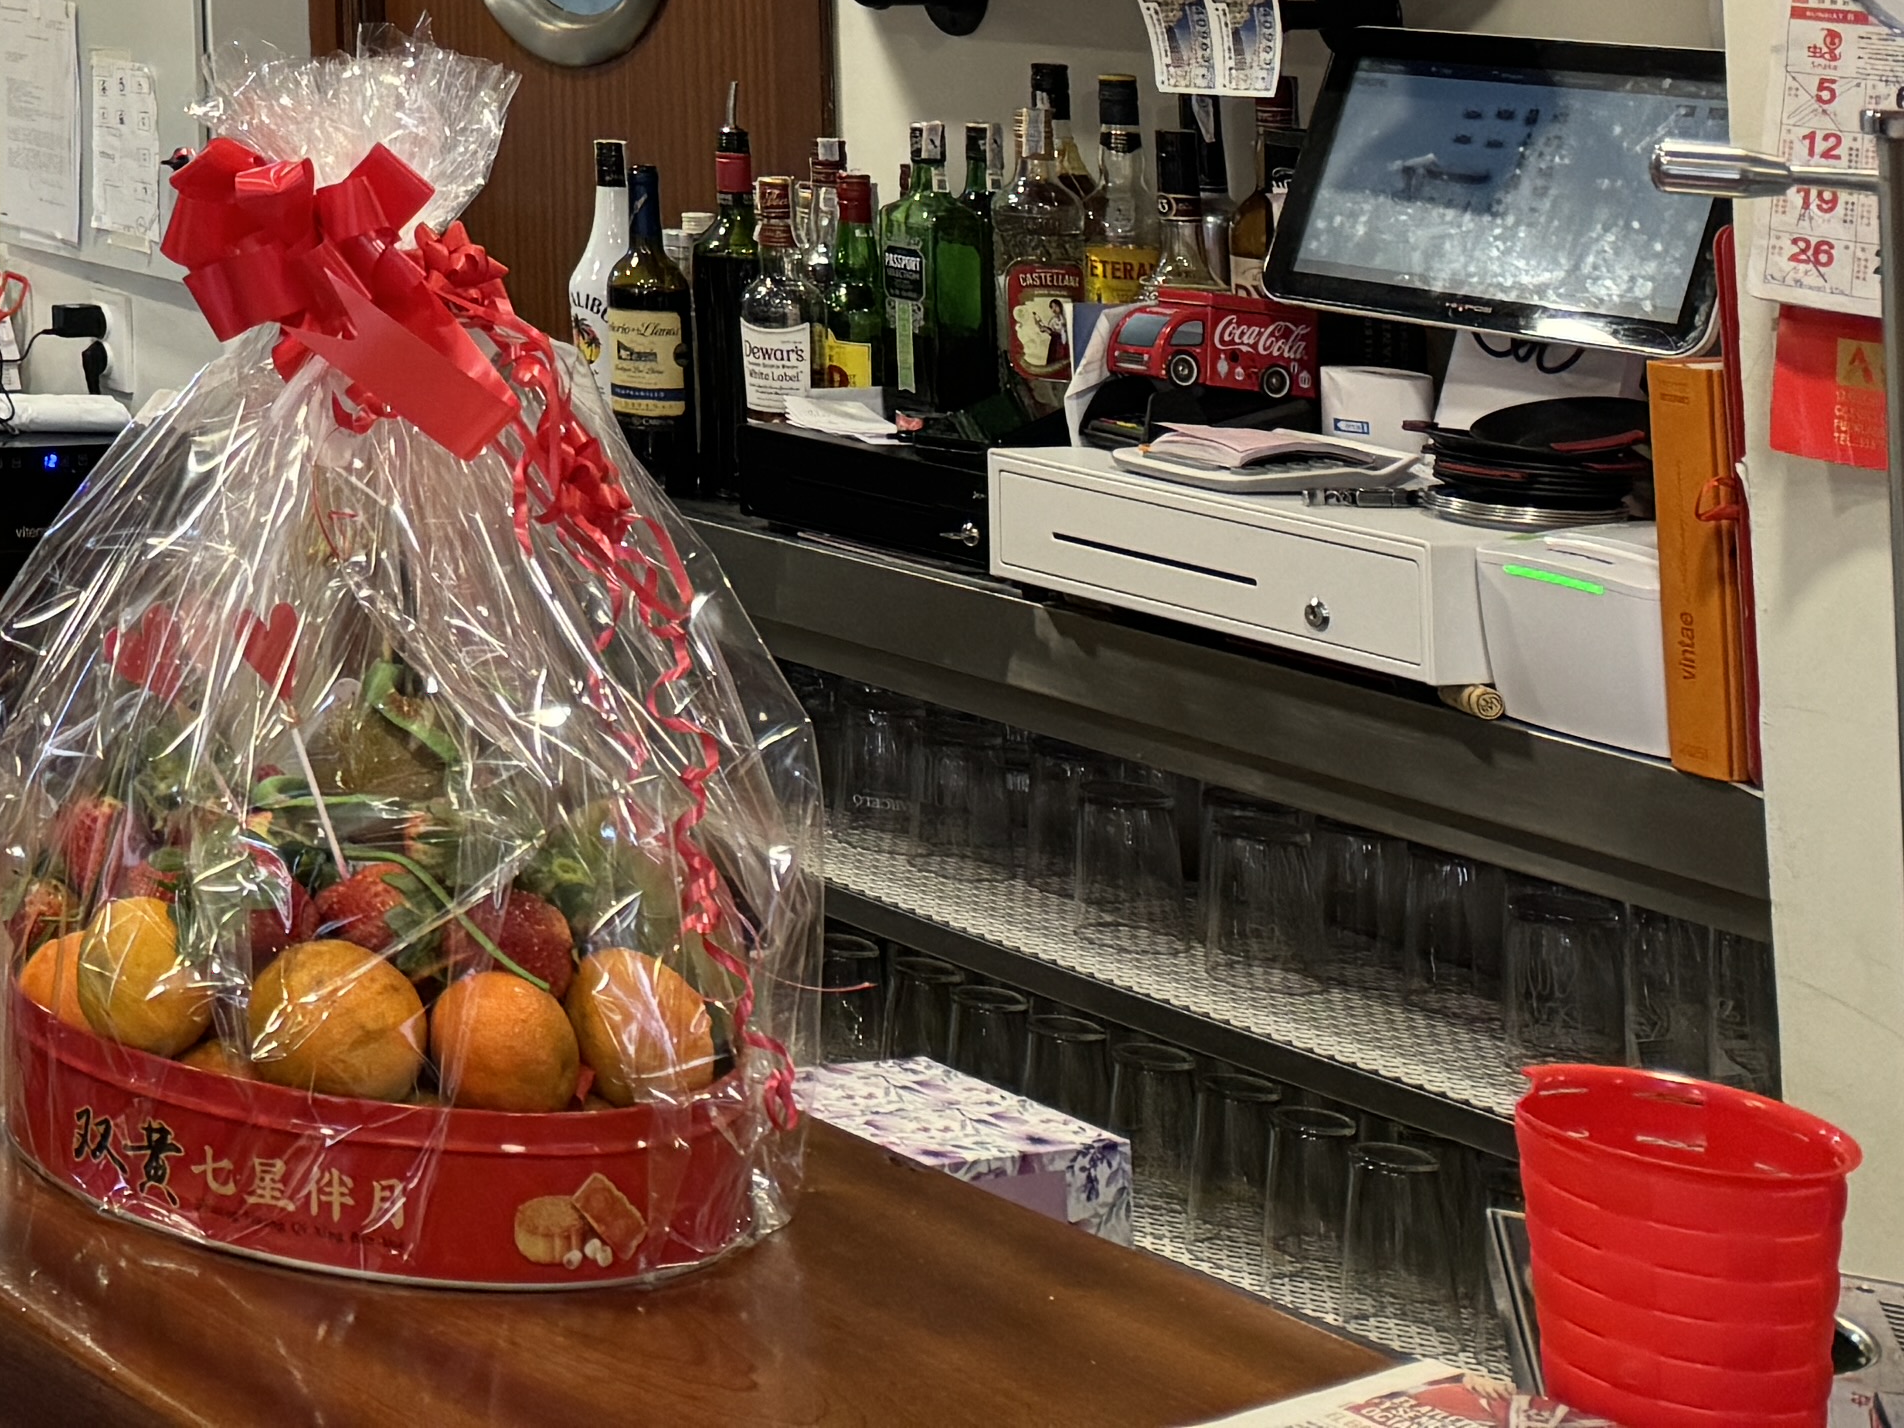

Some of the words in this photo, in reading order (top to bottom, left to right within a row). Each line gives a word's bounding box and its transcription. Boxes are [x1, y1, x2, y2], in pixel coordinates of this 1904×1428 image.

[1815, 77, 1838, 105] 5
[1802, 130, 1843, 160] 12
[1796, 187, 1839, 214] 19
[884, 251, 921, 272] PASSPORT
[1787, 236, 1836, 268] 26
[745, 340, 806, 363] Dewar's
[73, 1106, 184, 1208] 双黄
[191, 1145, 407, 1235] 七星伴月
